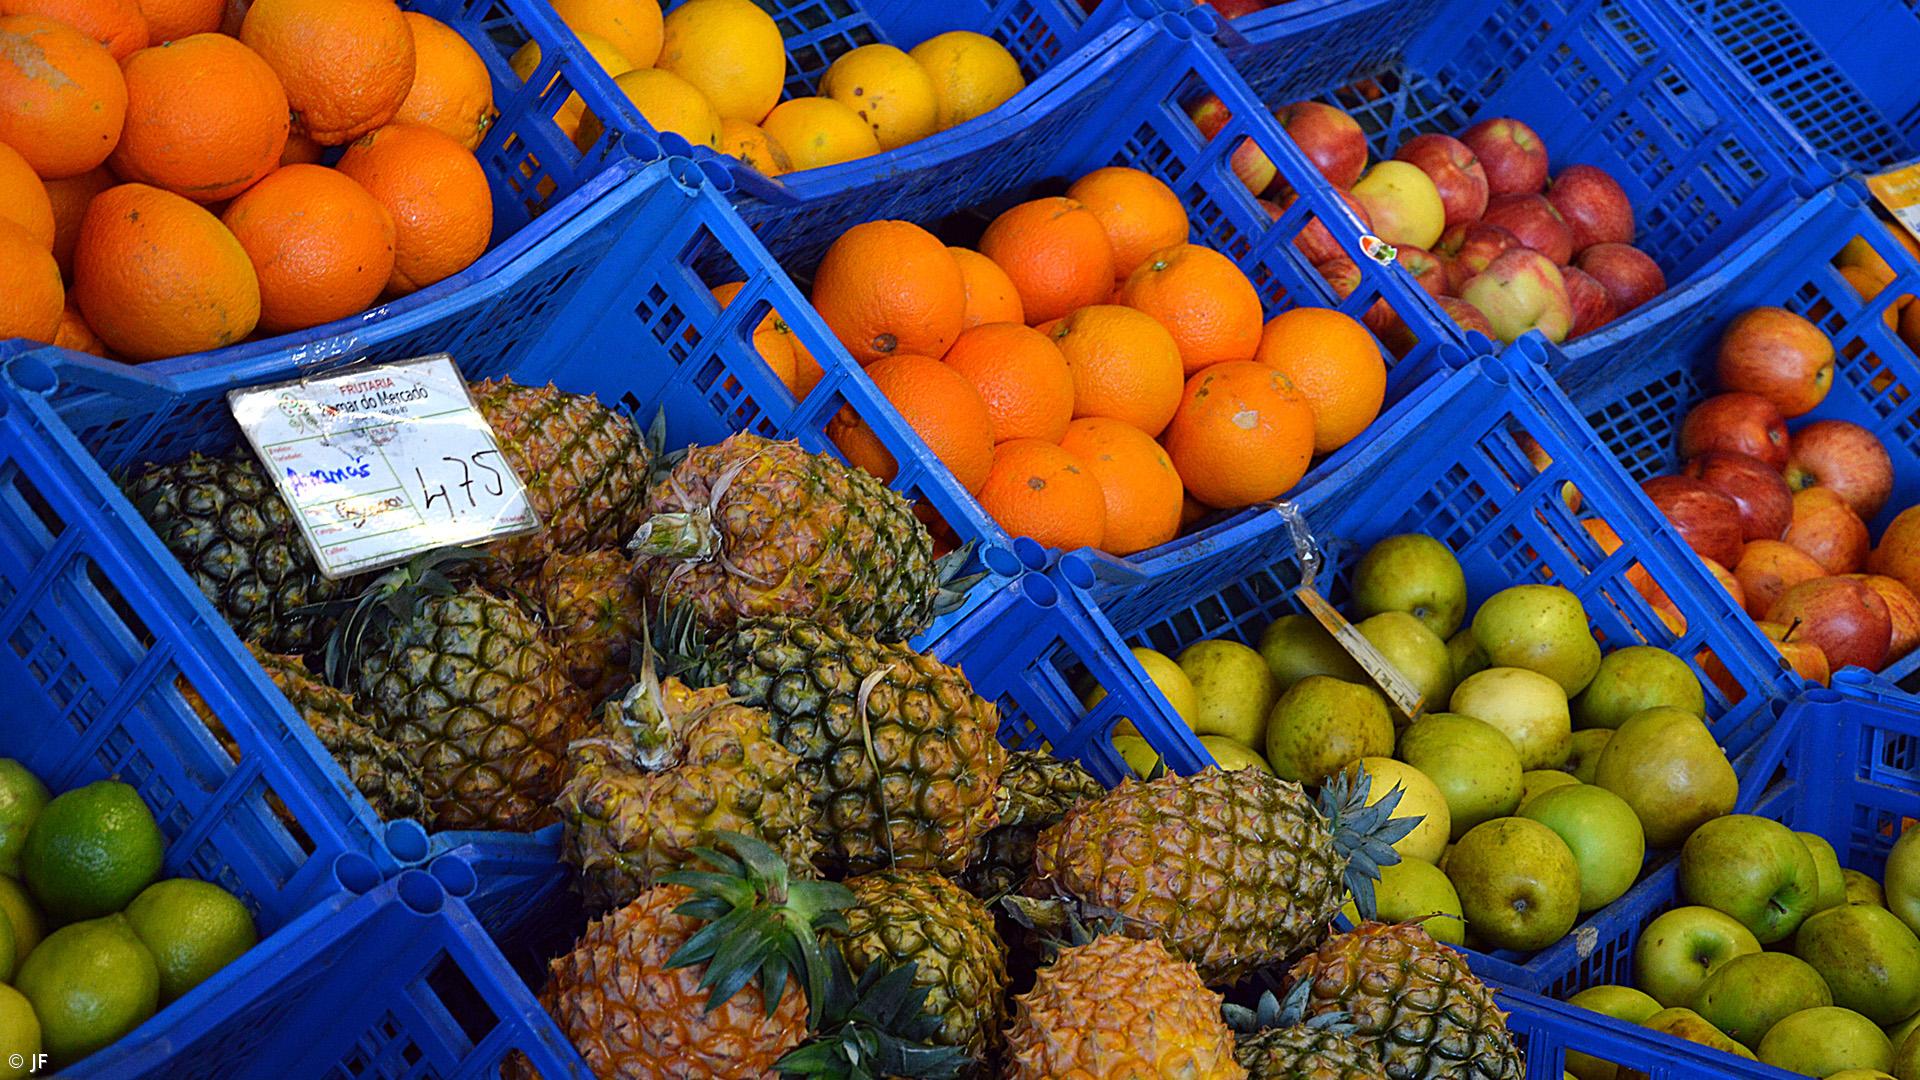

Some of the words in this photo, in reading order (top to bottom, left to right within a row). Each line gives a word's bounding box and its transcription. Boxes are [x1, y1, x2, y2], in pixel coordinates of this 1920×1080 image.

[339, 377, 395, 396] FRUTARIA
[360, 394, 377, 410] do
[377, 382, 429, 407] Mercado
